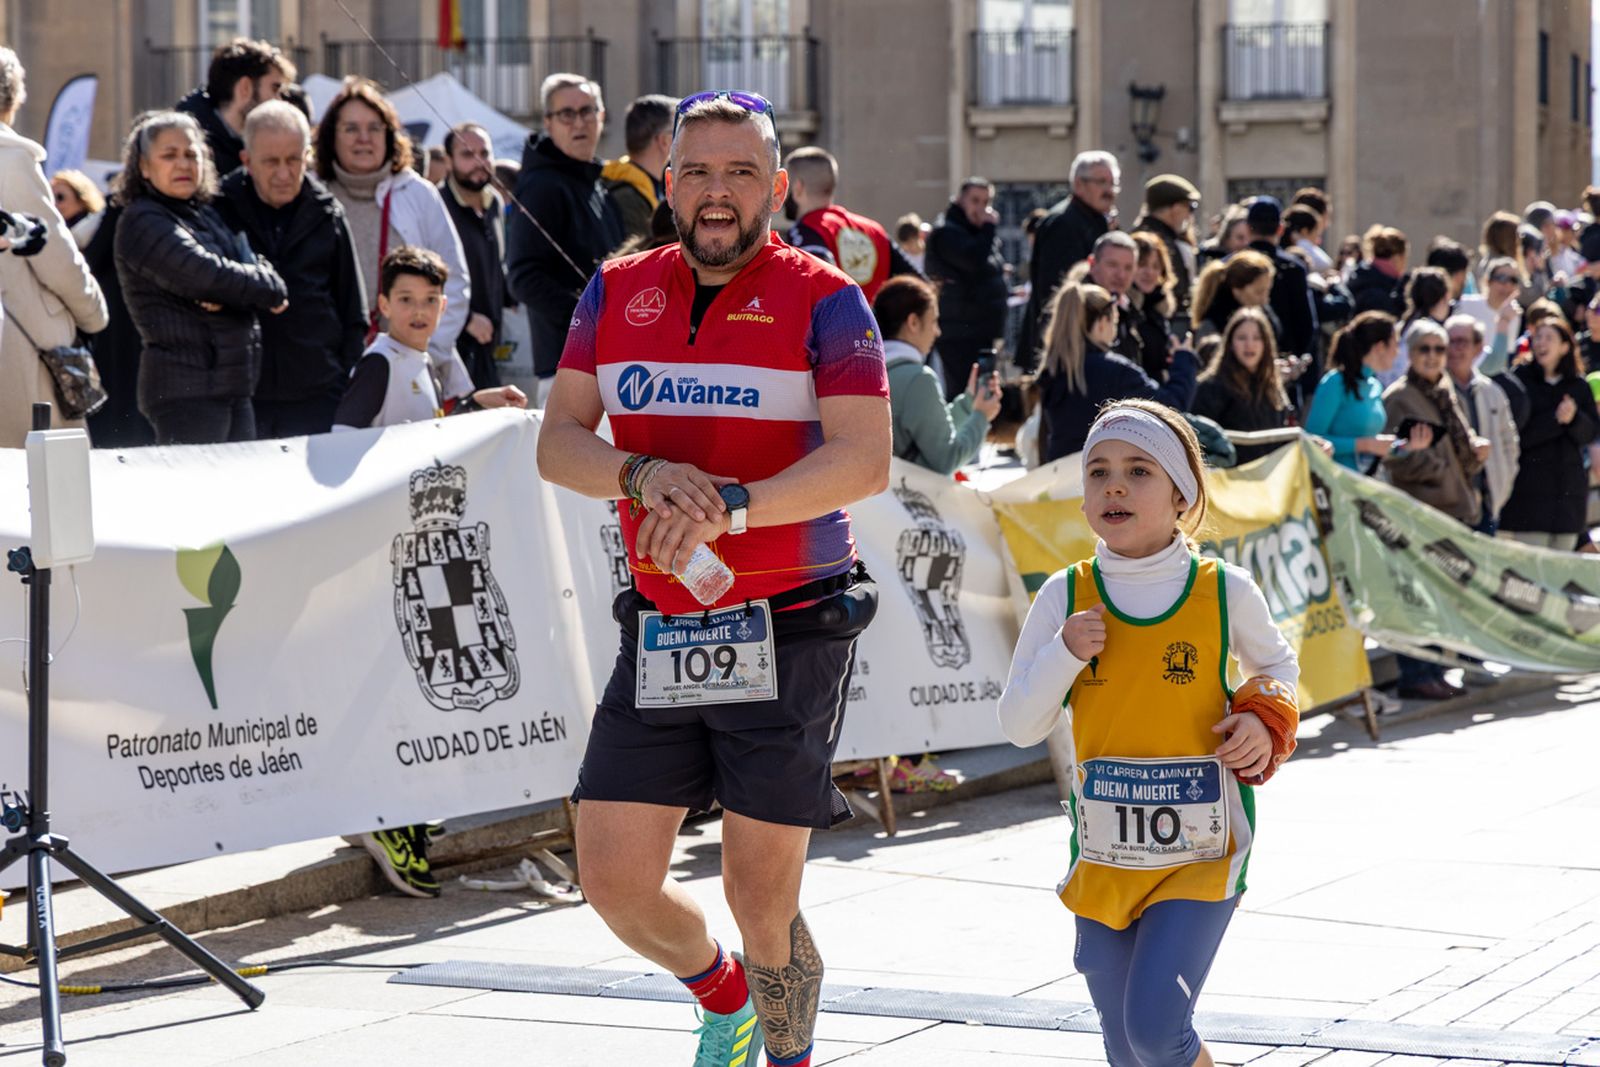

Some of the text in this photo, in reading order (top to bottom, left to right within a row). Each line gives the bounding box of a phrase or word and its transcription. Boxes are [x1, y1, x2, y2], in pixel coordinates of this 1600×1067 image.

[726, 313, 774, 324] BUITRAGO
[655, 377, 760, 408] Avanza
[677, 377, 698, 385] GRUPO
[656, 625, 732, 647] BUENA MUERTE
[670, 644, 737, 684] 109
[909, 683, 959, 707] CIUDAD
[960, 681, 977, 702] DE
[106, 712, 318, 759] Patronato Municipal de
[396, 711, 567, 766] CIUDAD DE JAÉN
[137, 746, 303, 793] Deportes de Jaén
[1095, 764, 1204, 779] VI CARRERA CAMINATA
[1093, 779, 1181, 801] BUENA MUERTE
[1115, 805, 1181, 846] 110
